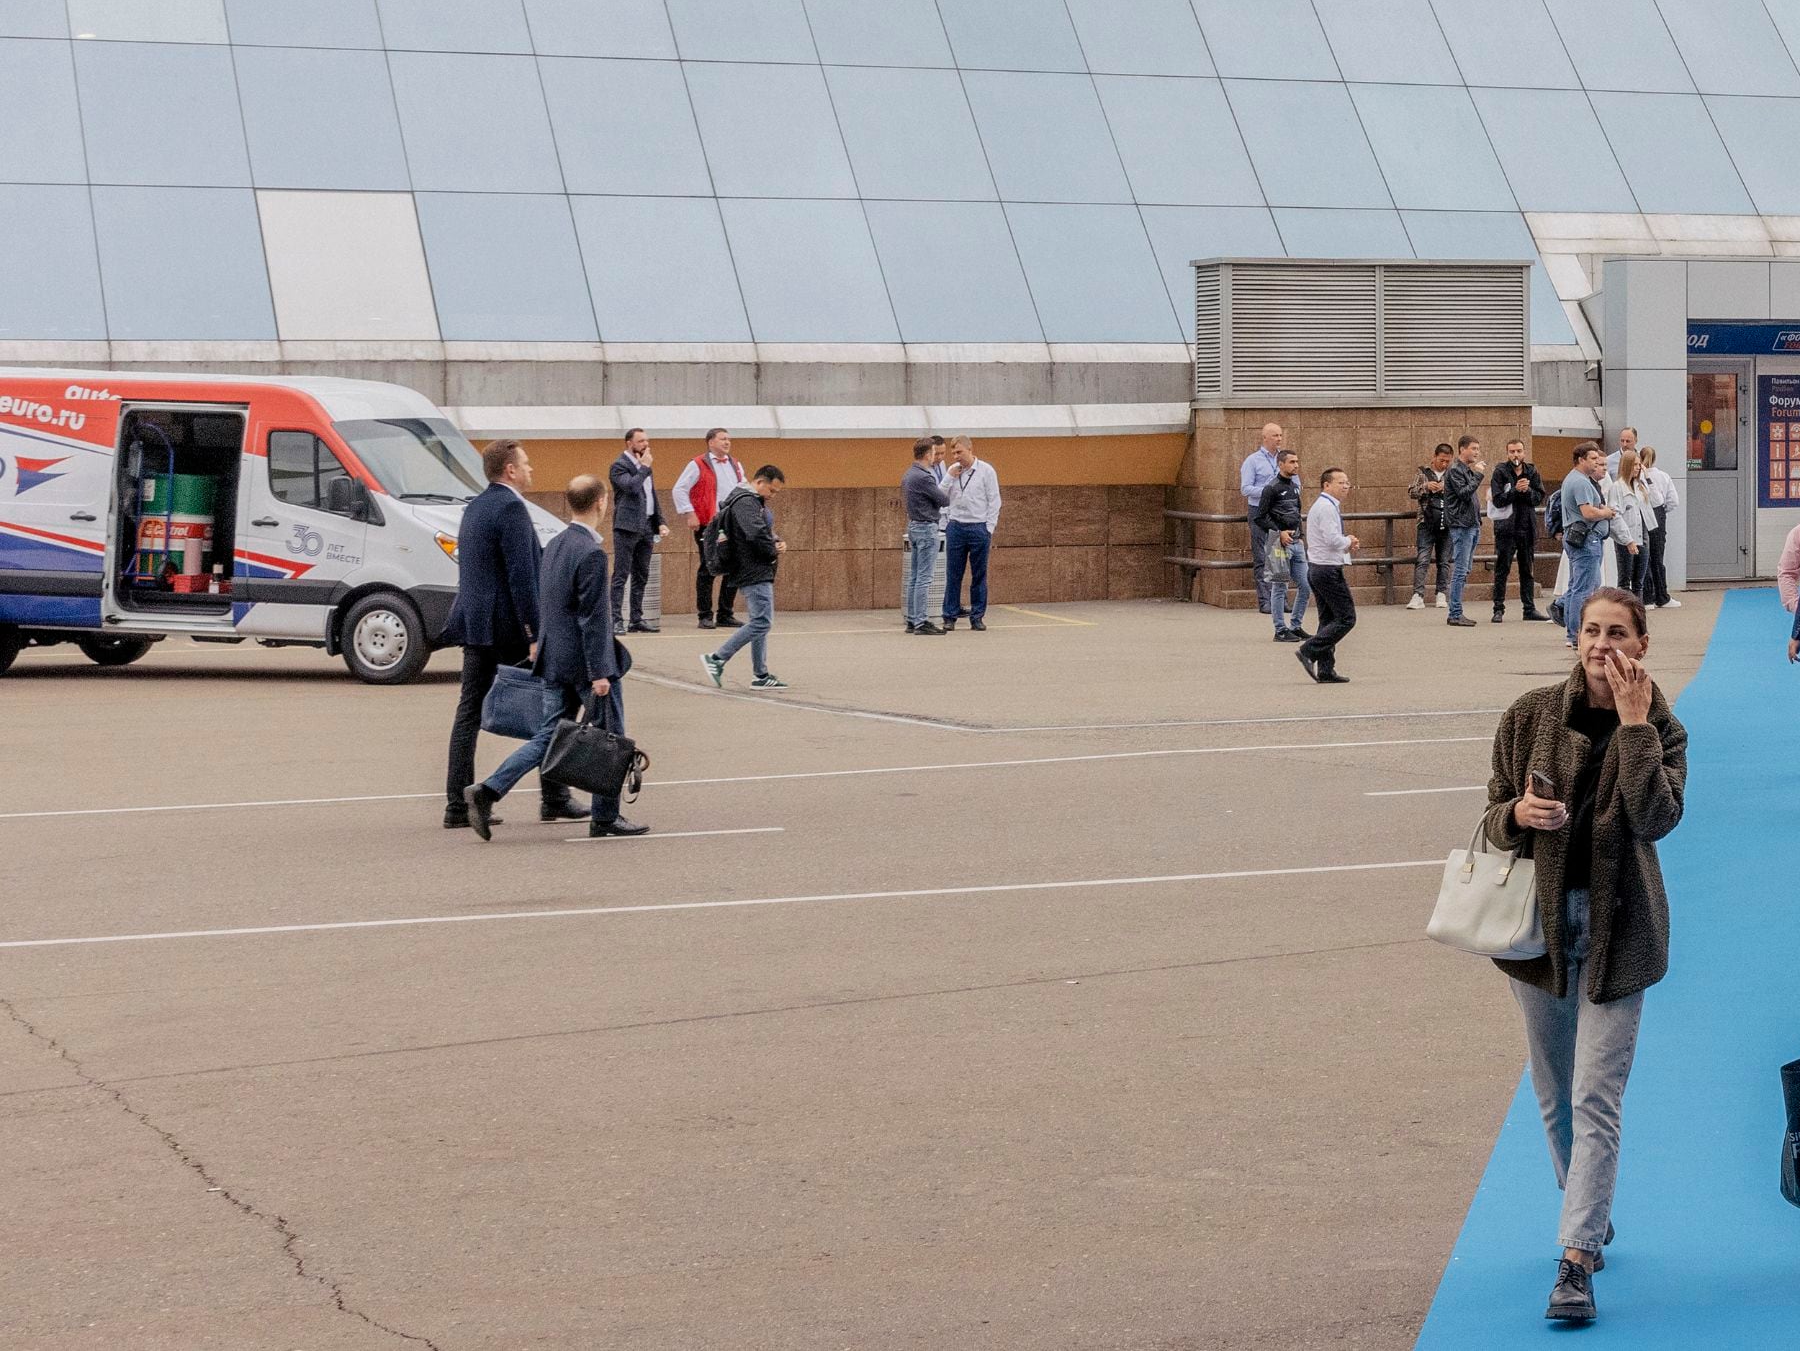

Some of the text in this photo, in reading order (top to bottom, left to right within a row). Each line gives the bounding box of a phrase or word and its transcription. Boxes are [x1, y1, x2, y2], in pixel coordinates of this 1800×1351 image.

[1687, 334, 1709, 348] ОД
[0, 396, 86, 430] euro.ru
[1772, 407, 1800, 417] Forum
[153, 525, 190, 537] Catrol
[327, 544, 345, 554] ЛЕТ
[326, 553, 361, 565] ВМЕСТЕ
